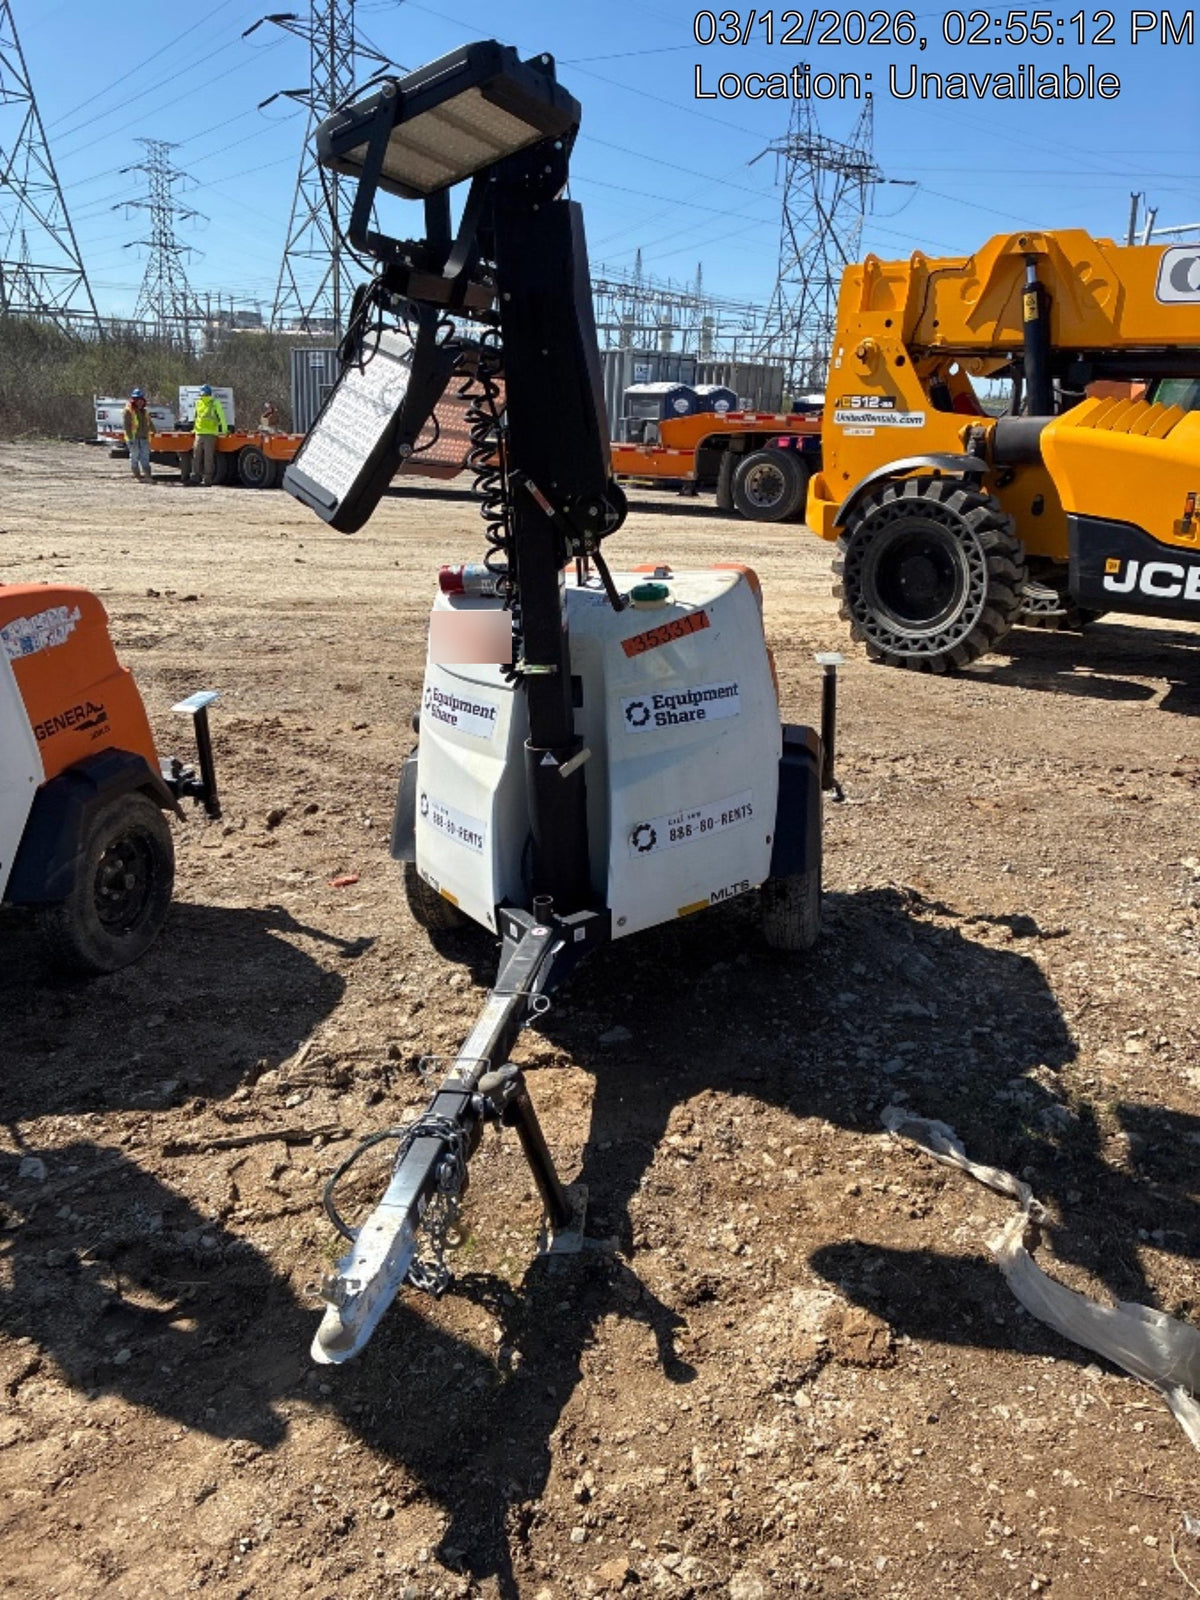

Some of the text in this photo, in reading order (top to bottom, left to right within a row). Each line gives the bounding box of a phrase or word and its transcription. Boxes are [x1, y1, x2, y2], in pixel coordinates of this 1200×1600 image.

[433, 687, 497, 720] Equipment
[651, 682, 739, 710] Equipment
[431, 703, 458, 726] Share
[654, 708, 706, 726] Share
